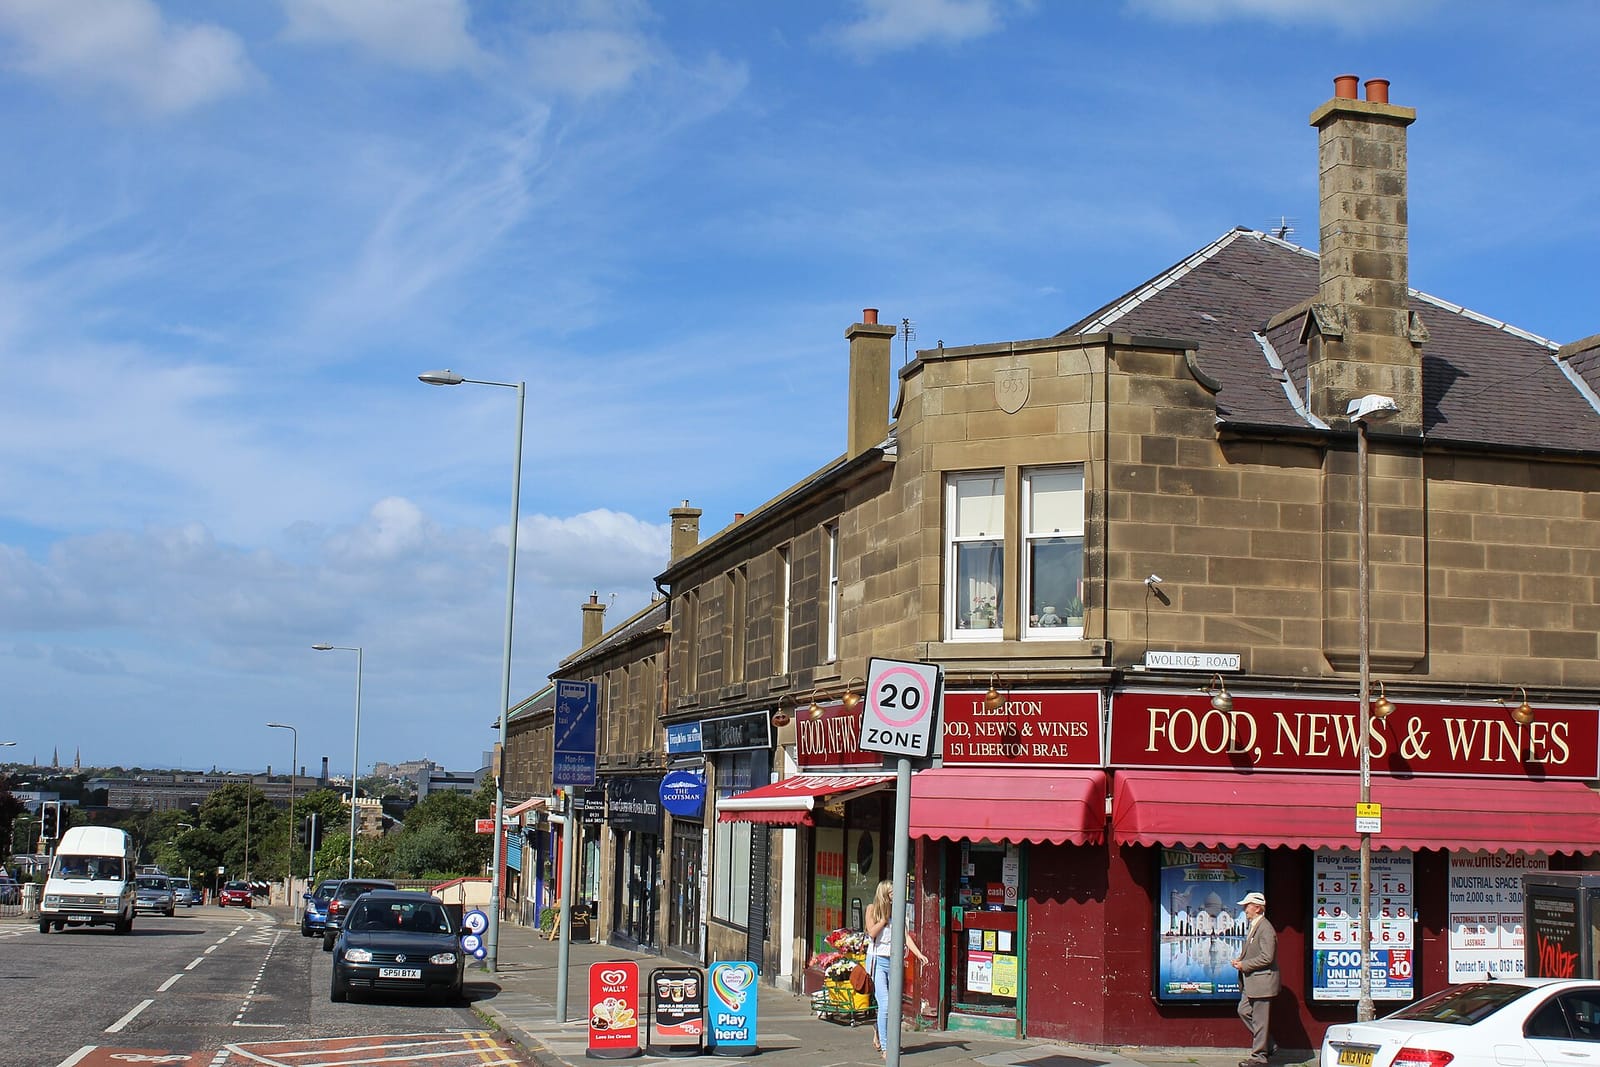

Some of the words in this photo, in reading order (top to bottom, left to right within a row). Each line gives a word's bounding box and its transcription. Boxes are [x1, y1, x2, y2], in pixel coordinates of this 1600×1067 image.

[1206, 656, 1238, 667] ROAD
[880, 684, 920, 710] 20
[975, 722, 1017, 737] NEWS
[1021, 722, 1034, 737] &
[1037, 721, 1089, 738] WINES
[1144, 707, 1262, 765] FOOD,
[1272, 712, 1387, 759] NEWS
[1400, 716, 1432, 760] &
[1442, 717, 1570, 765] WINES
[800, 717, 828, 762] FOOD,
[827, 714, 857, 754] NEWS
[867, 728, 922, 749] ZONE
[950, 743, 964, 756] 151
[969, 743, 1029, 757] LIBERTON
[1032, 743, 1069, 757] BRAE
[1164, 852, 1190, 865] WIN
[1317, 855, 1340, 864] Enjoy
[1451, 877, 1493, 888] INDUSTRIAL
[1495, 878, 1518, 888] SPACE
[988, 888, 1004, 896] cash
[1450, 893, 1464, 902] from
[1327, 951, 1361, 967] 500
[1389, 961, 1411, 976] £10
[1500, 960, 1513, 972] 0131
[1327, 969, 1386, 979] UNLIMED
[718, 1013, 746, 1028] Play
[715, 1028, 748, 1040] here!
